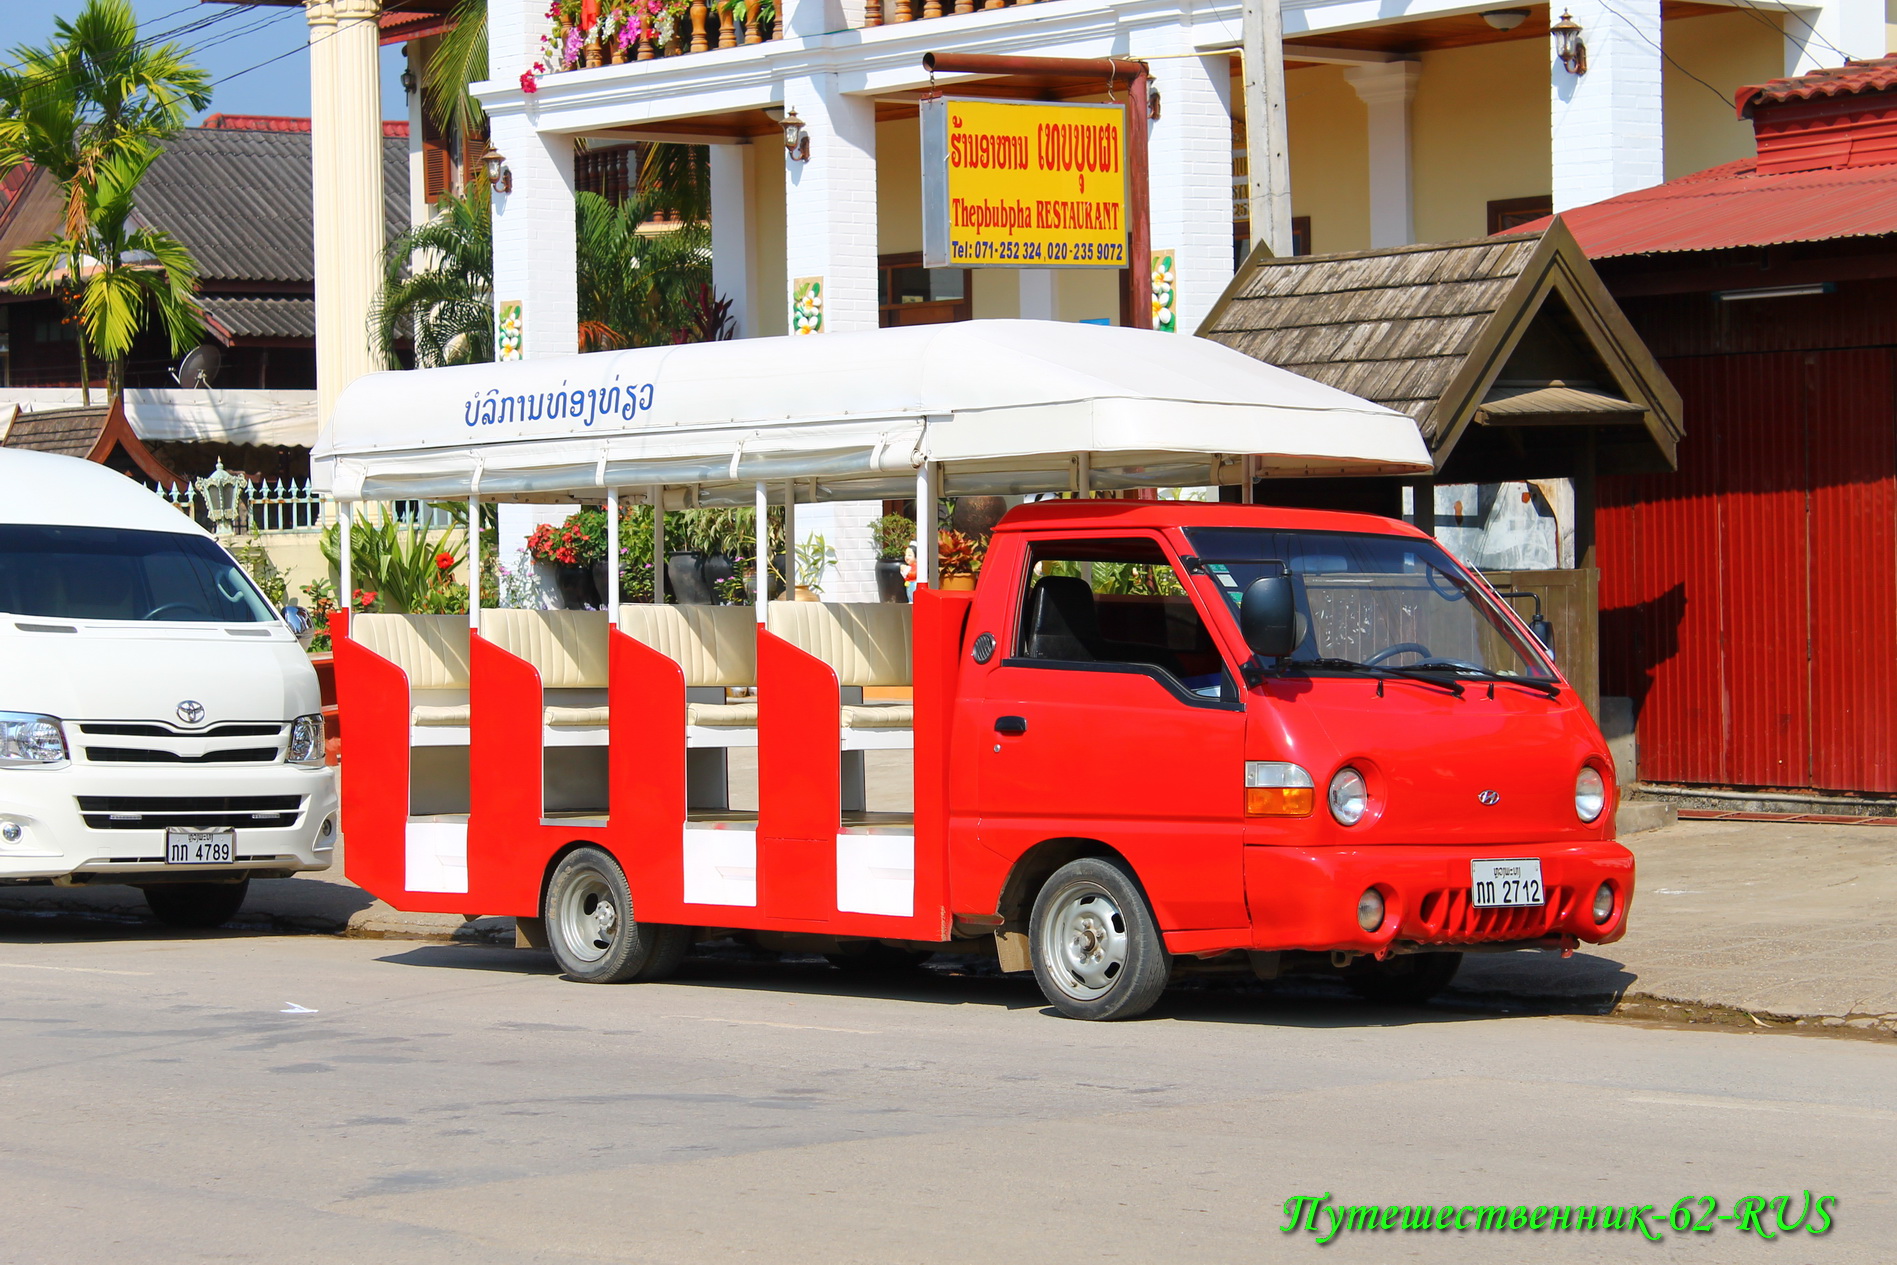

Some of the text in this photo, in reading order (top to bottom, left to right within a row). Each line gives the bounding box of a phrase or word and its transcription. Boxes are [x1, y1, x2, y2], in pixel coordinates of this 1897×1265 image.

[950, 115, 1029, 170] ຮ້ານອາຫານ
[952, 197, 1119, 236] Thepbubpha RESTAURANT
[951, 241, 972, 259] Tel:
[1096, 243, 1123, 260] 9072
[465, 374, 655, 427] ບໍລິການທ່ອງທ່ຽວ
[195, 843, 230, 861] 4789
[1502, 879, 1540, 903] 2712
